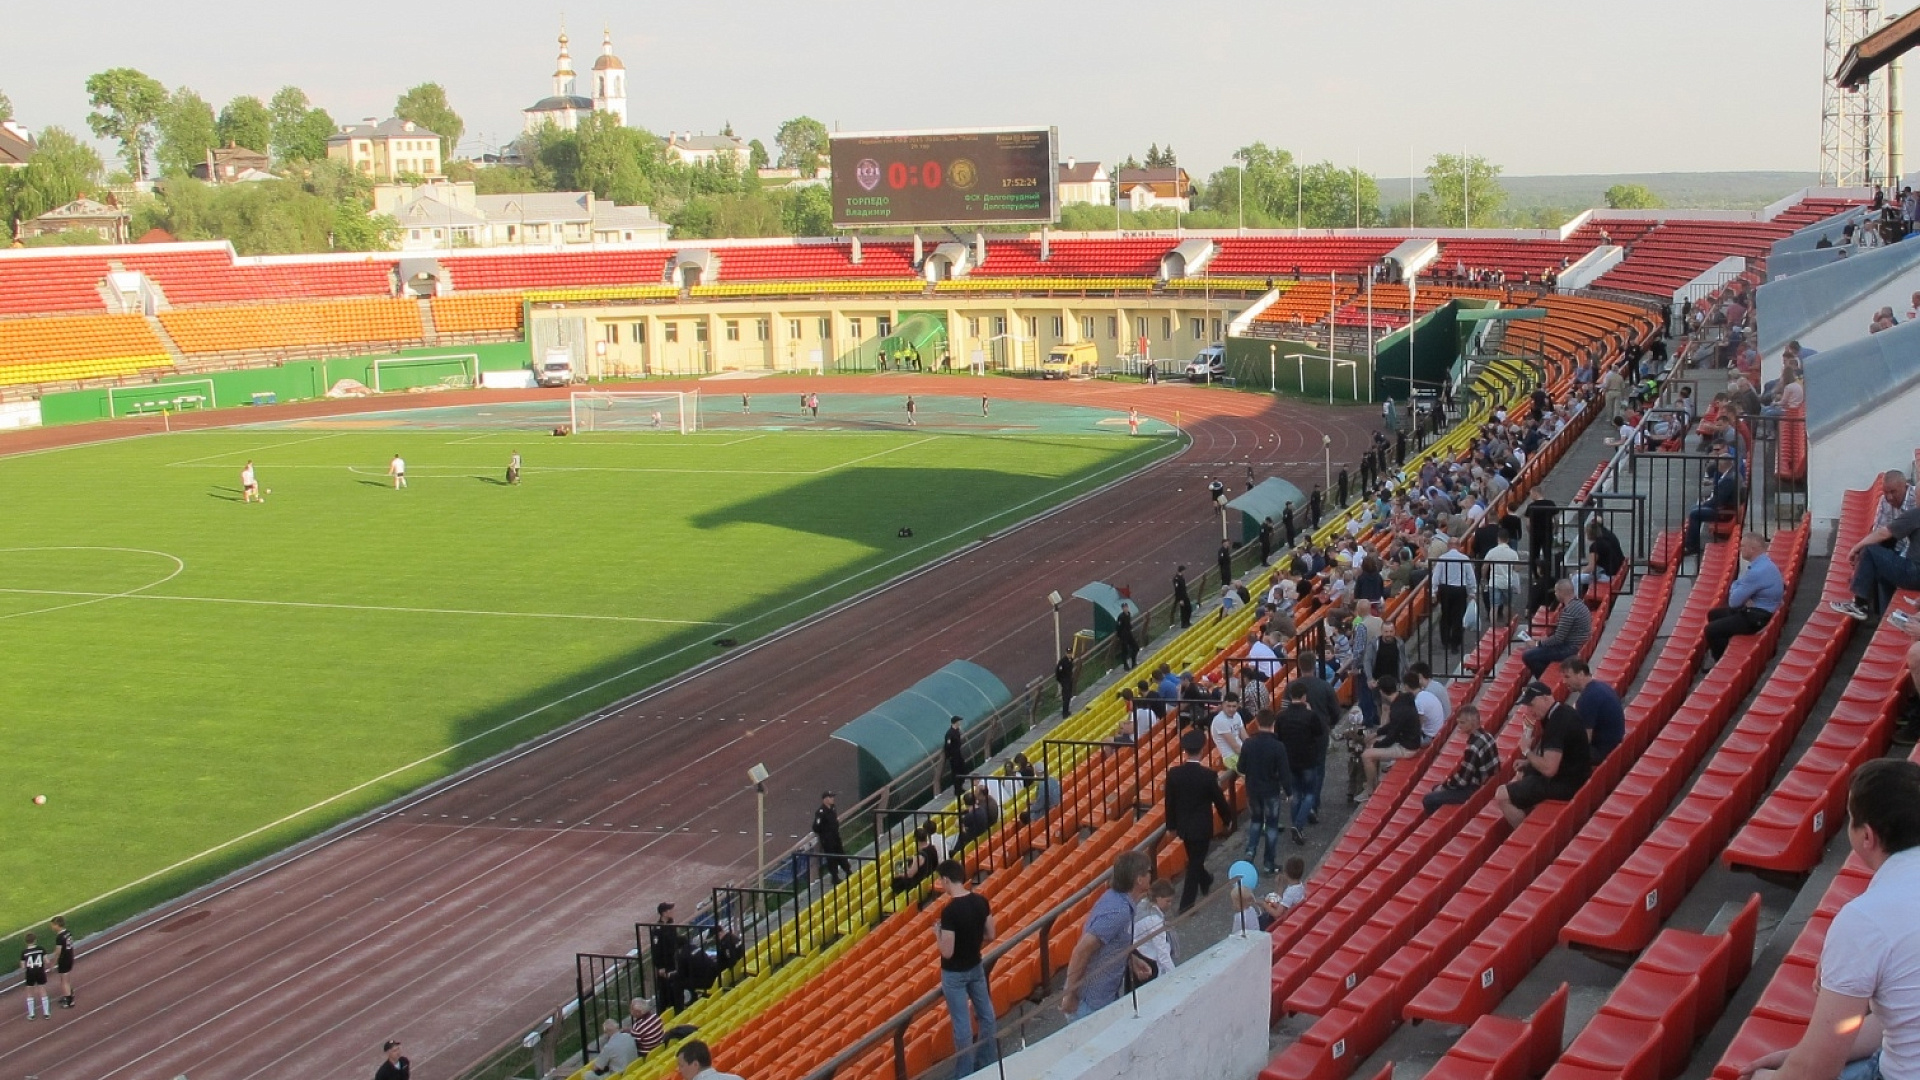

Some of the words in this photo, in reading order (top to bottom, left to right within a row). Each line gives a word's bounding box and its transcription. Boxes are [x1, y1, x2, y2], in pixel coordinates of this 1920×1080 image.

[888, 160, 941, 190] 0:0
[1002, 177, 1036, 187] 17:52:24
[846, 197, 890, 206] ТОРПЕДО
[846, 209, 891, 217] Владимир
[26, 955, 42, 968] 44
